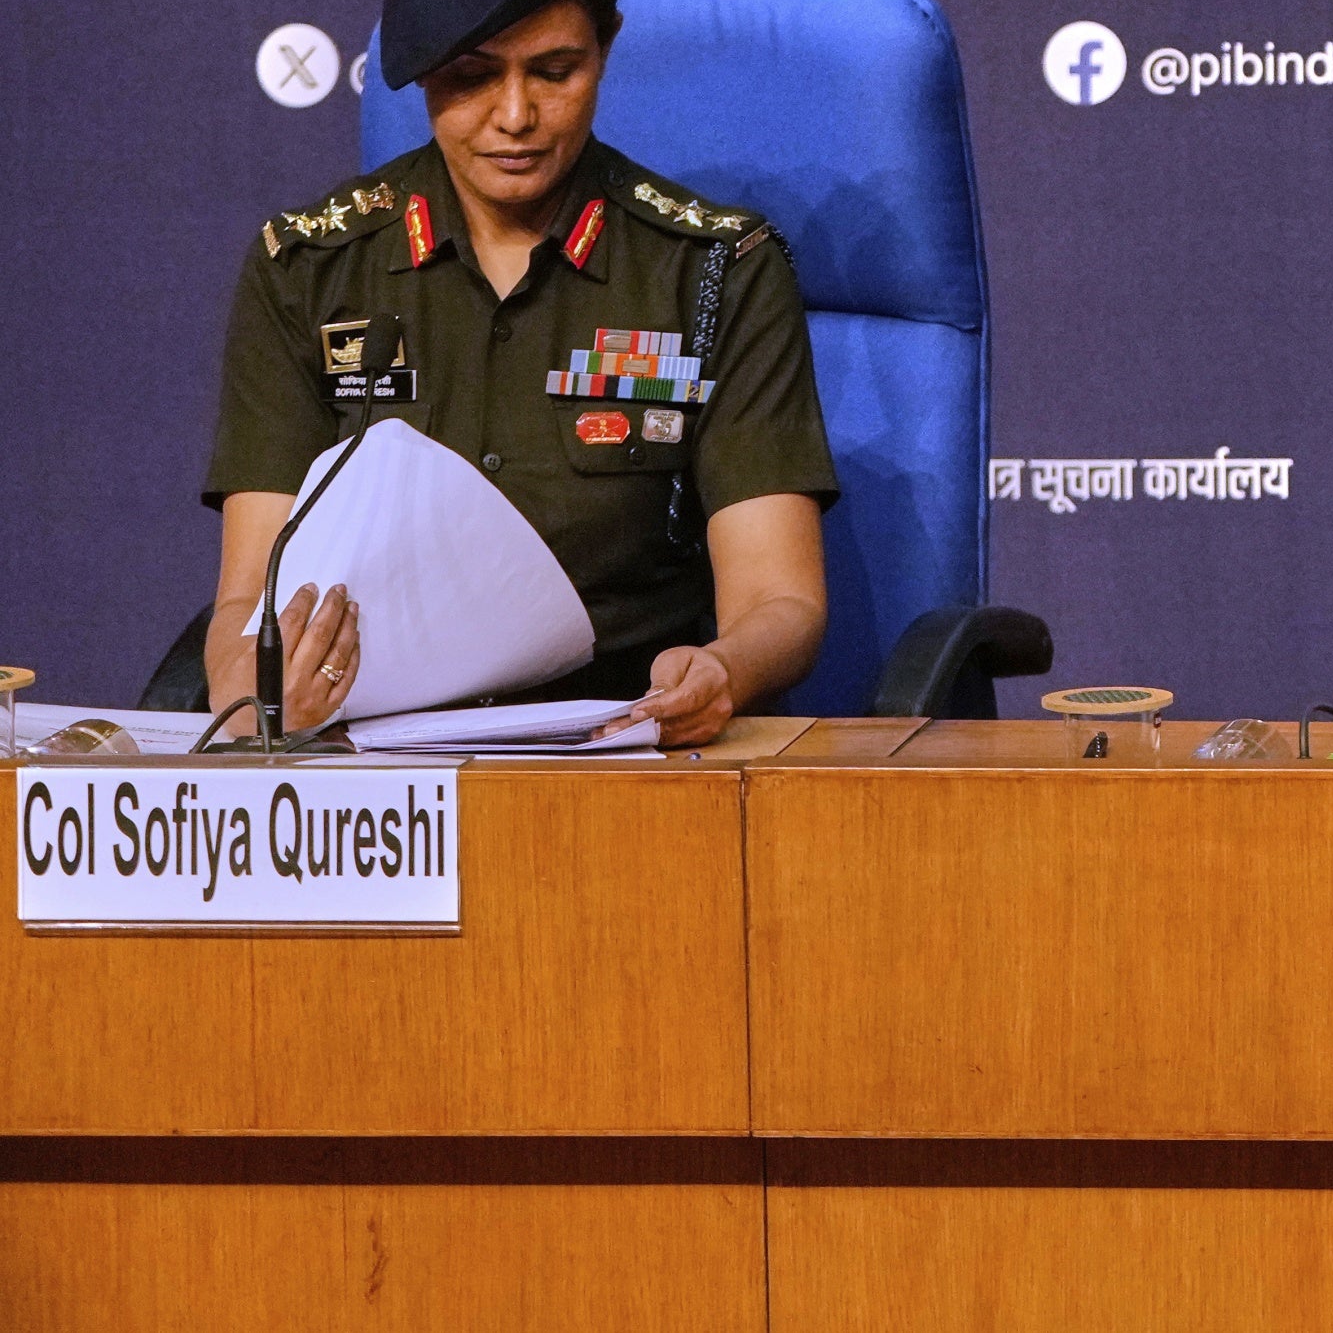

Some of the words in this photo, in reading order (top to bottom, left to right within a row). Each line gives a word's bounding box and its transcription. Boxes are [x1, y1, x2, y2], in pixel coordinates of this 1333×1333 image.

[1029, 458, 1138, 515] सूचना
[1140, 446, 1295, 501] कार्यालय
[23, 781, 95, 876] Col
[113, 781, 253, 902] Sofiya
[269, 782, 446, 885] Qureshi
